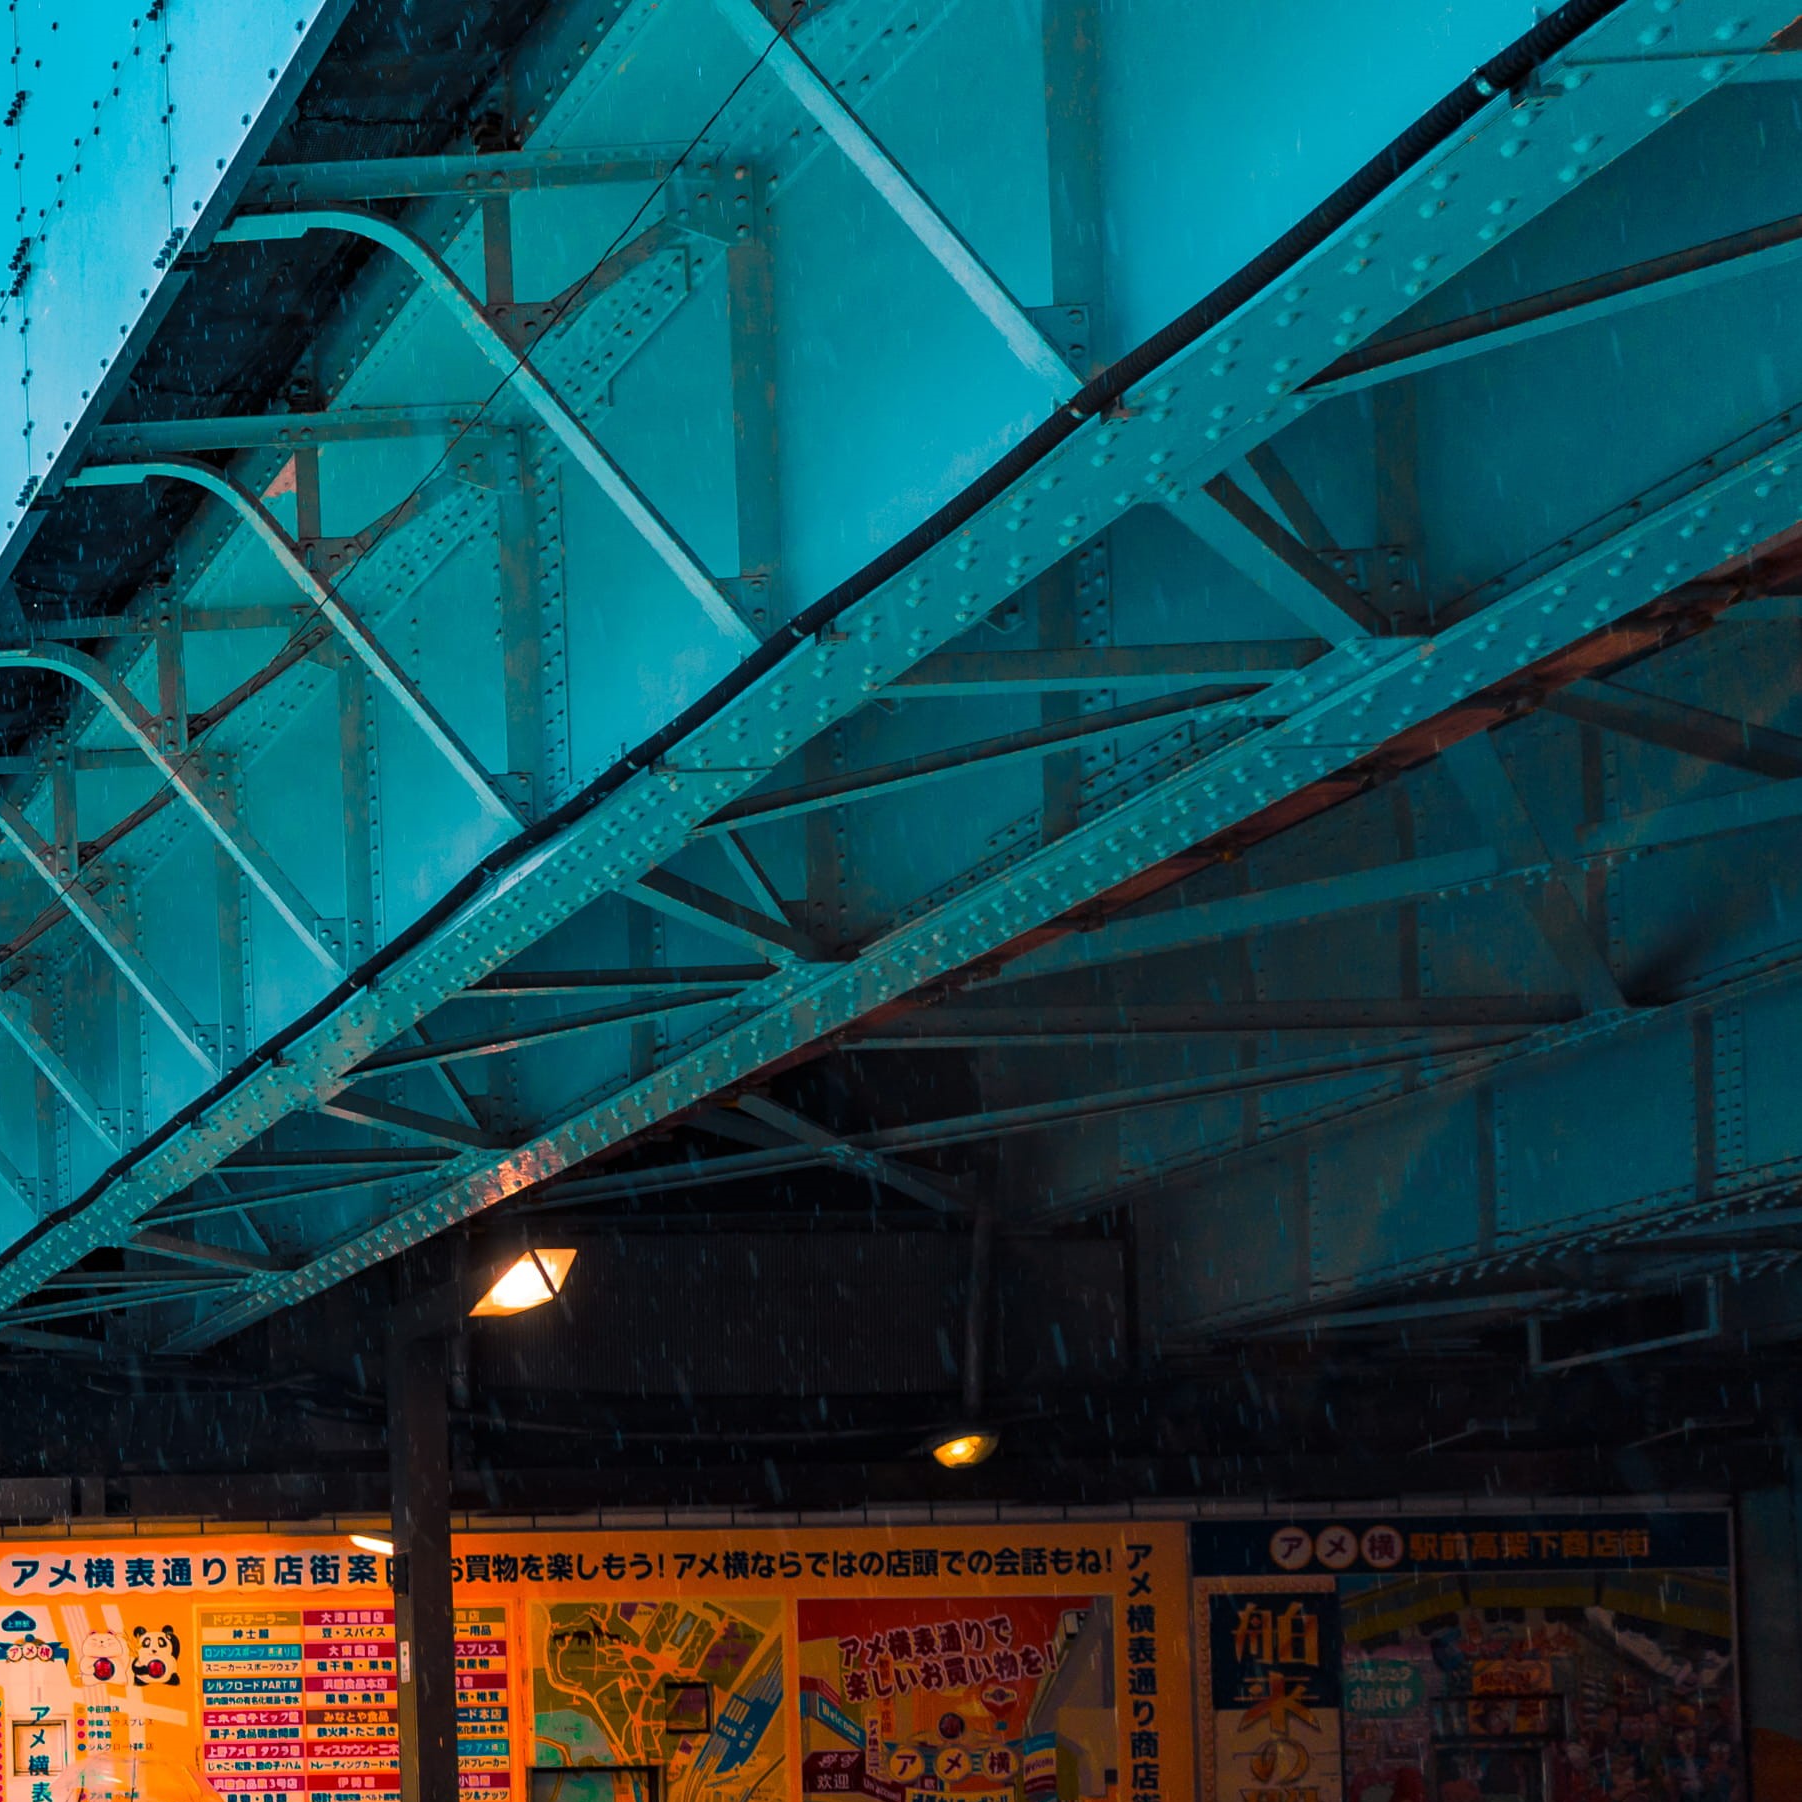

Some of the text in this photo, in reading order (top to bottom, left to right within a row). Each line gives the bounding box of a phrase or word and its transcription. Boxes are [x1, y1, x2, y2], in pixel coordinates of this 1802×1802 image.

[322, 1628, 386, 1638] 豆・スパイス
[839, 1614, 1012, 1668] アメ横表通りで
[816, 1774, 850, 1790] 欢迎
